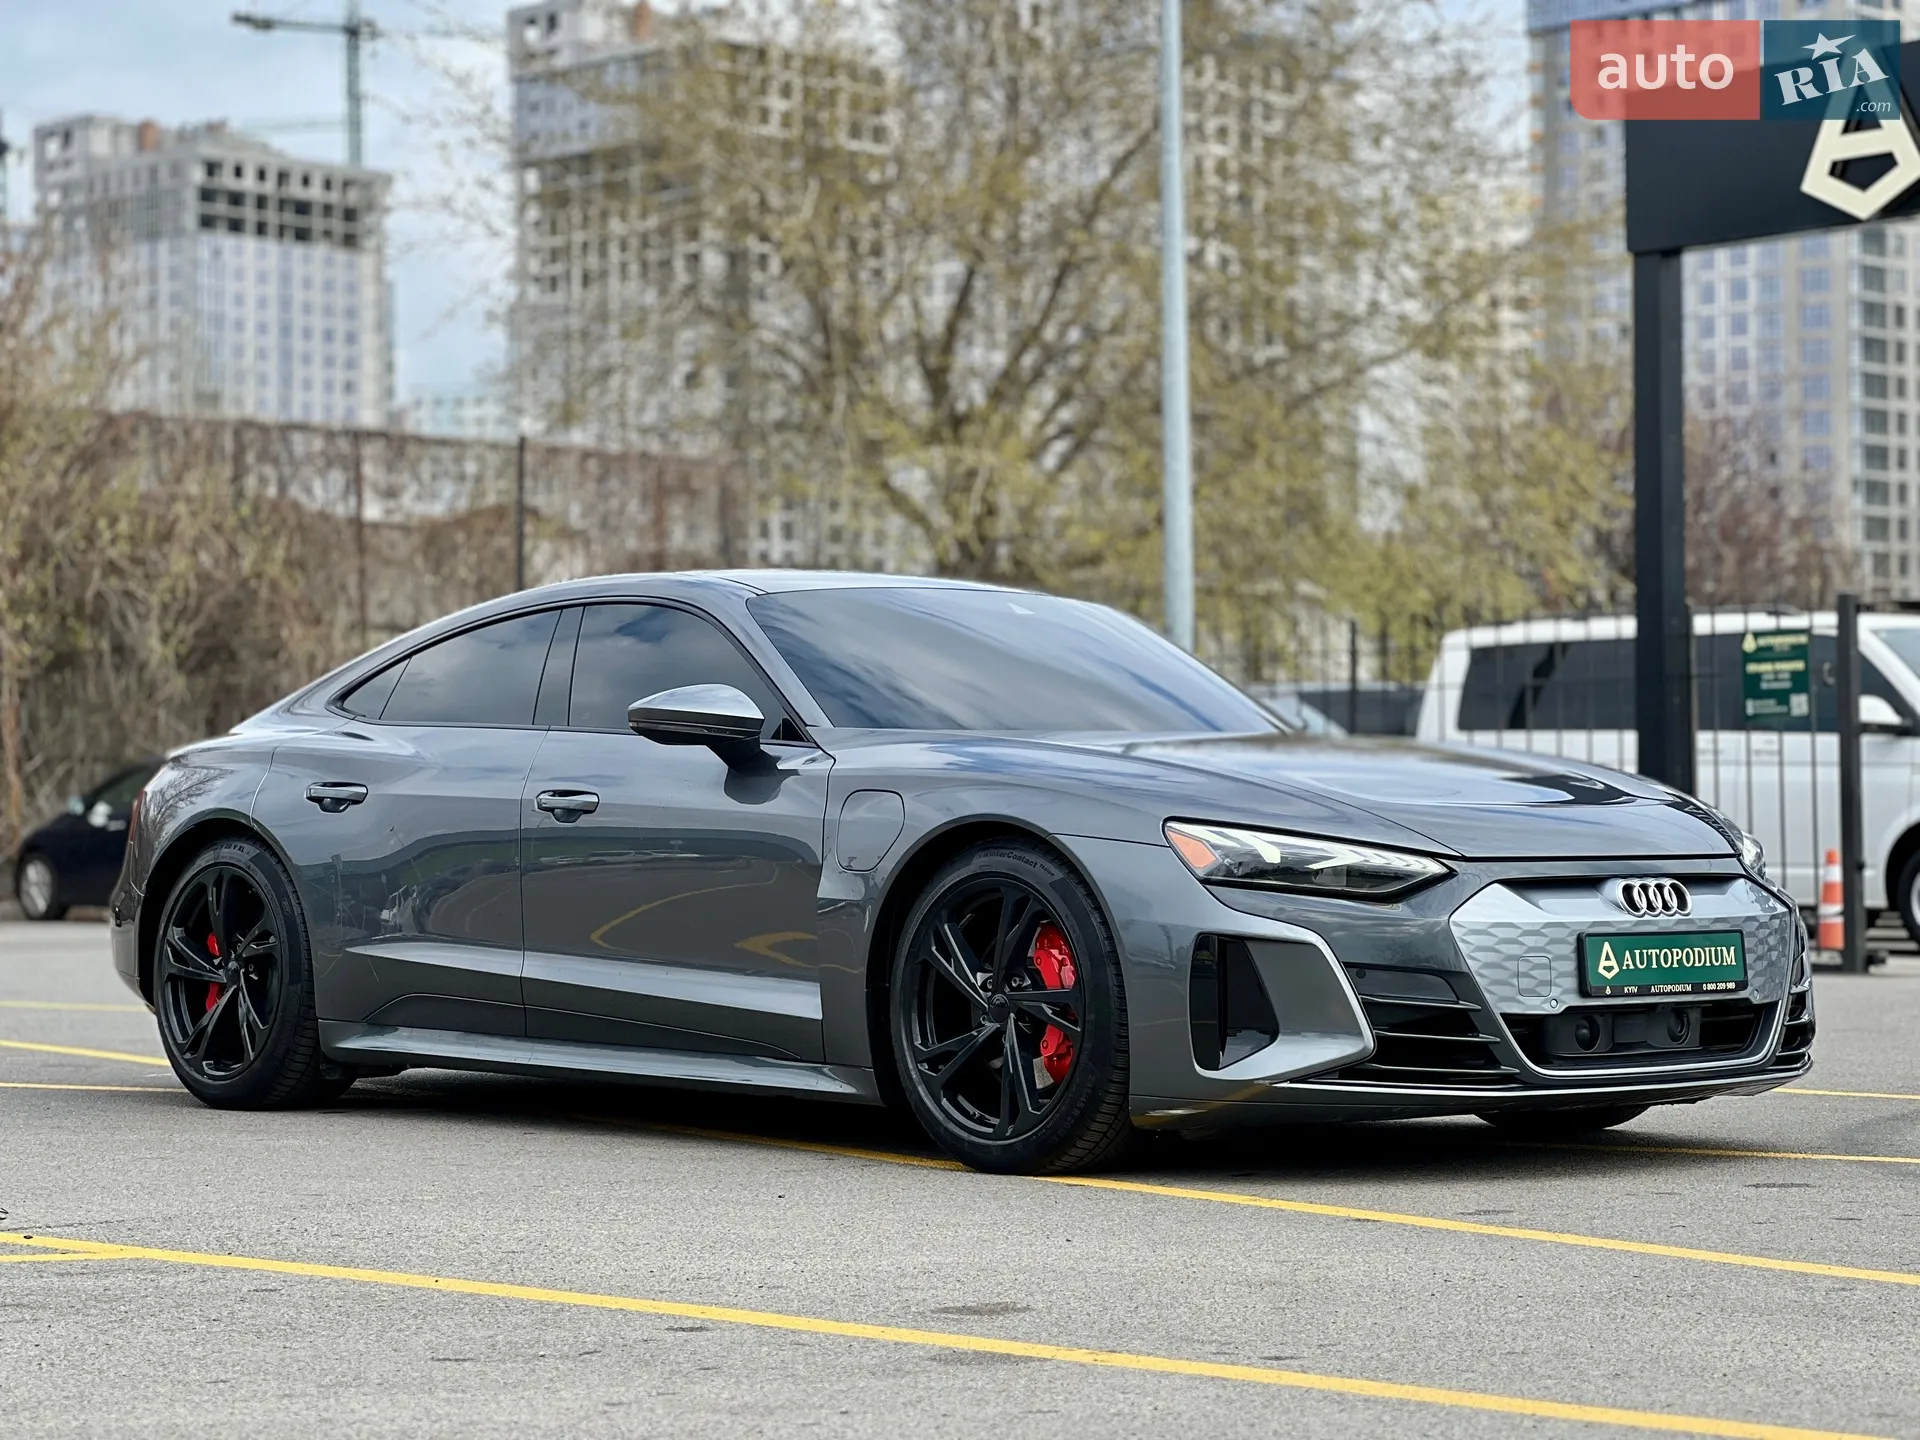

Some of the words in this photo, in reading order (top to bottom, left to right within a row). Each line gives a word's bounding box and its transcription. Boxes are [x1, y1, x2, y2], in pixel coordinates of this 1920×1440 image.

[1622, 946, 1737, 970] AUTOPODIUM
[1624, 986, 1639, 994] KYIV
[1650, 983, 1692, 993] AUTOPODIUM
